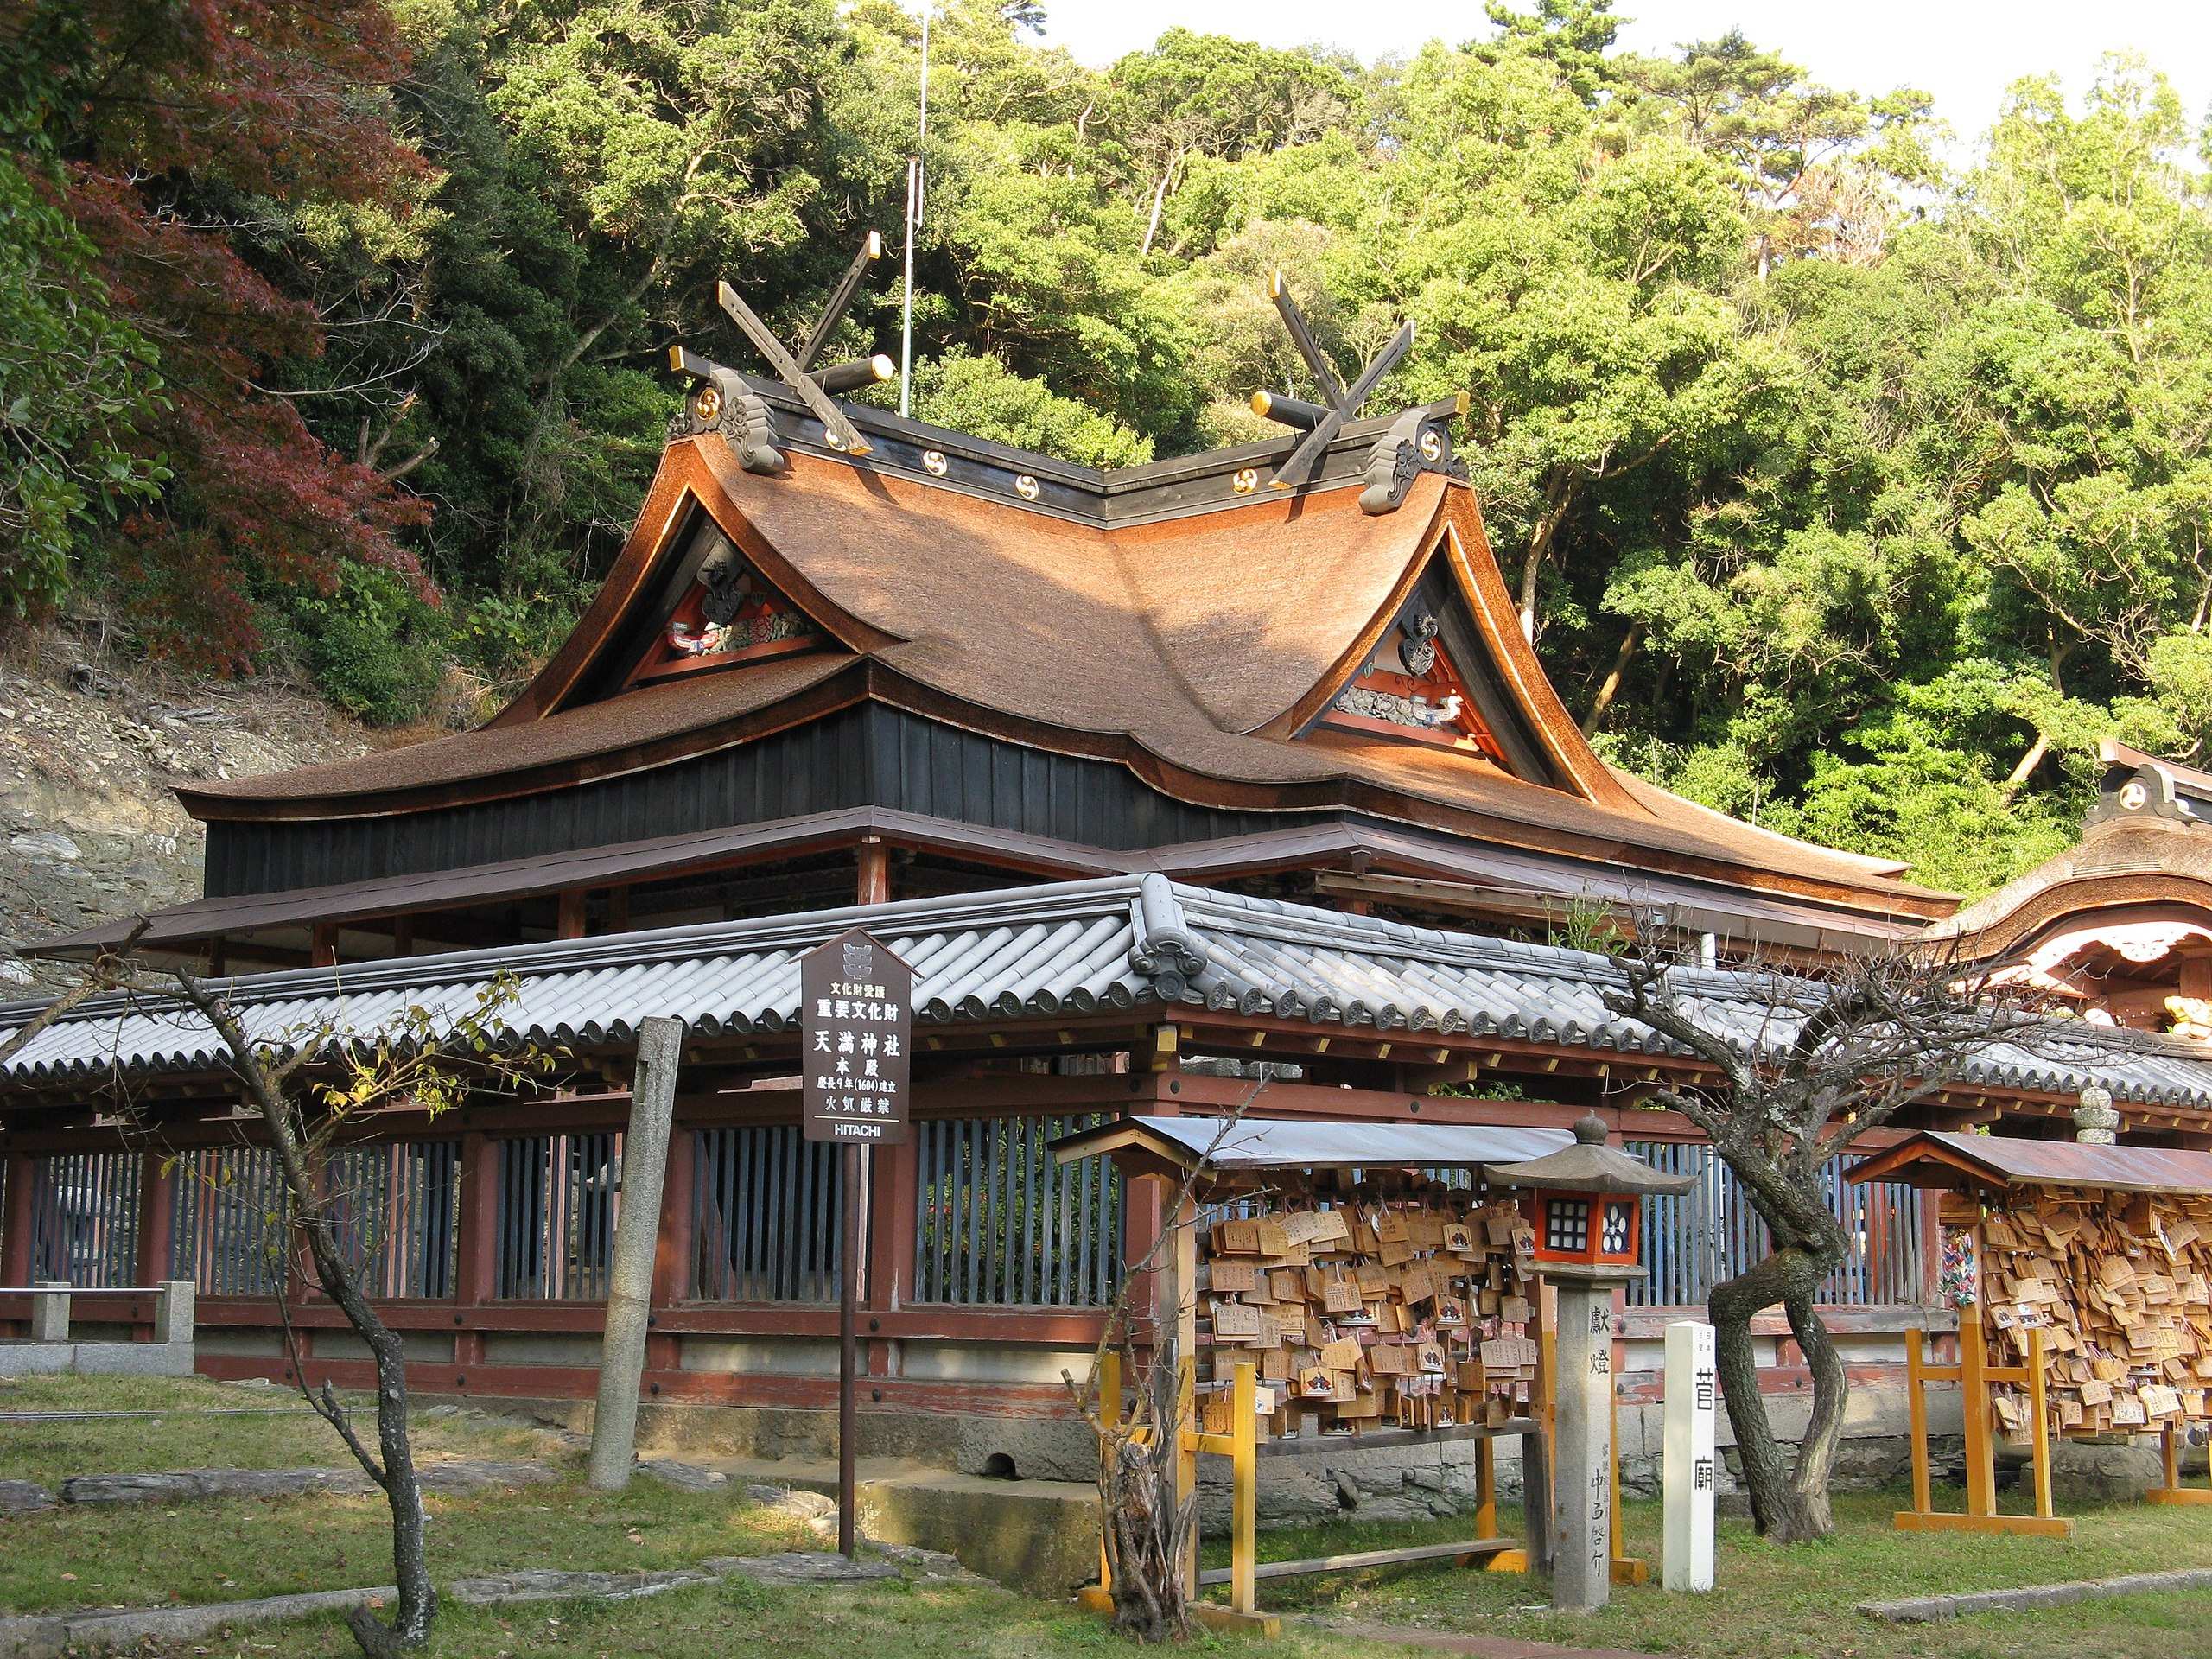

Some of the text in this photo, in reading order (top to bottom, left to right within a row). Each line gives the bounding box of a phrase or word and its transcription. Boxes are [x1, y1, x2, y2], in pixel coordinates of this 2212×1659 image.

[817, 998, 899, 1022] 重要文化財
[813, 1030, 900, 1057] 天満神社
[835, 1056, 879, 1077] 本殿
[825, 1096, 890, 1115] 火気厳禁
[834, 1124, 880, 1137] HITACHI
